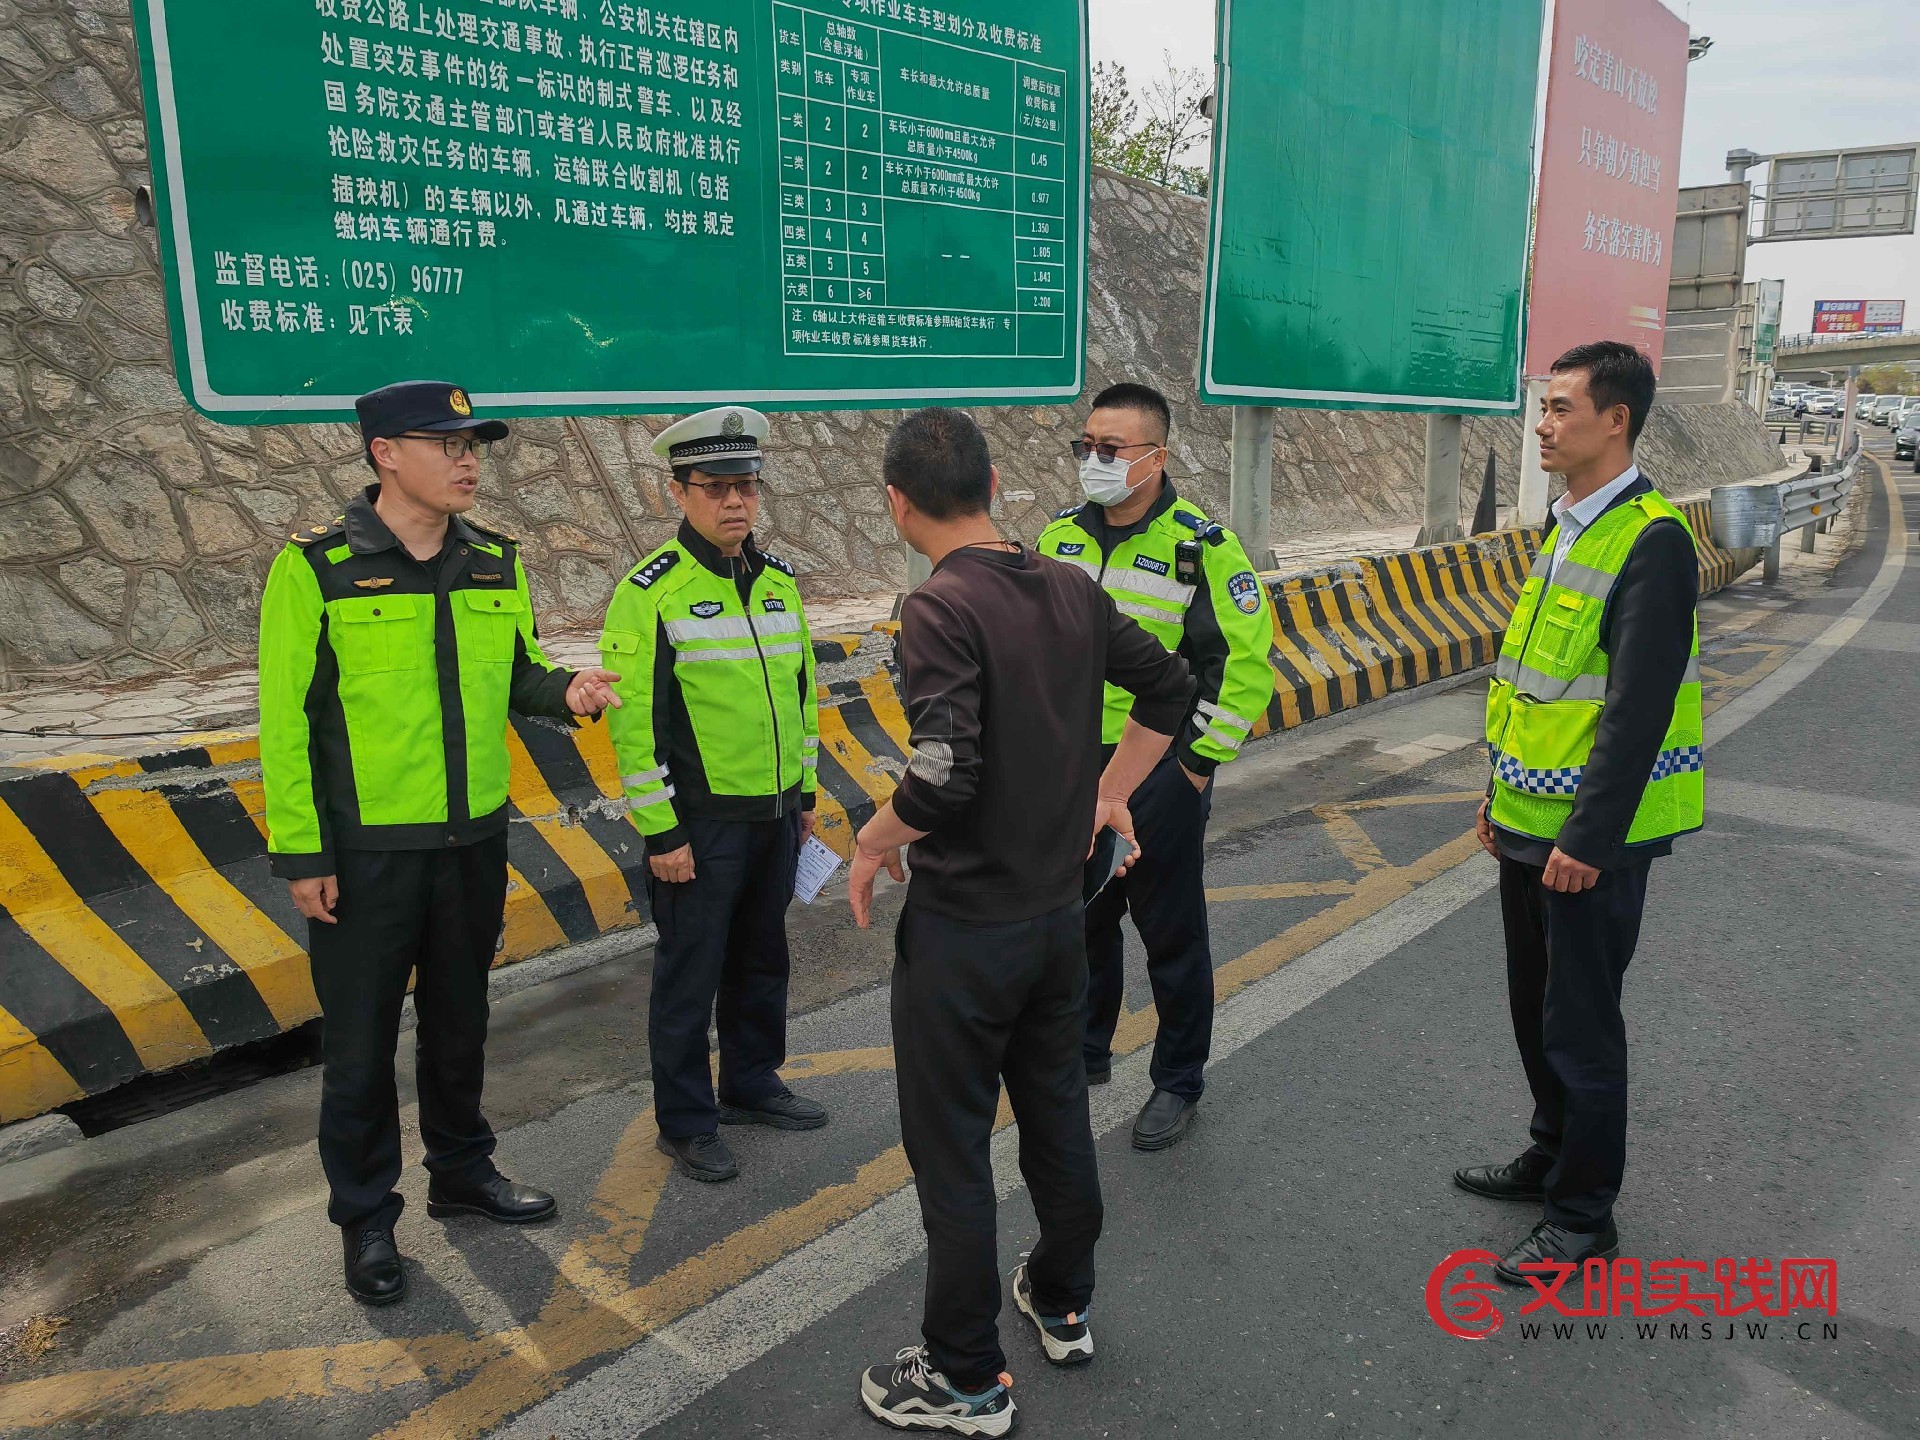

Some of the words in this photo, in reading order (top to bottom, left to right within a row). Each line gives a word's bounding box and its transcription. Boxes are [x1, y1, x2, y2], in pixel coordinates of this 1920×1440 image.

[779, 28, 801, 47] 货车
[826, 20, 857, 42] 总轴数
[780, 58, 802, 76] 类别
[814, 69, 835, 86] 货车
[850, 68, 871, 85] 专项
[846, 85, 876, 103] 作业车
[900, 67, 991, 100] 车长和最大允许总质量
[1025, 94, 1057, 113] 收费标准
[323, 80, 740, 165] 国务院交通主管部门或者省人民政府批准执行
[781, 112, 804, 128] 一类
[825, 116, 832, 132] 2
[862, 124, 869, 138] 2
[783, 155, 805, 171] 二类
[825, 161, 832, 176] 2
[861, 165, 868, 180] 2
[1031, 152, 1048, 167] 0.45
[1578, 125, 1661, 194] 只争朝夕勇担当
[783, 193, 805, 209] 三类
[825, 197, 832, 212] 3
[861, 202, 868, 217] 3
[1031, 192, 1050, 204] 0.977
[333, 210, 507, 248] 缴纳车辆通行费。
[784, 225, 806, 241] 四类
[825, 227, 832, 242] 4
[861, 231, 868, 246] 4
[1582, 209, 1662, 267] 务实落实善作为
[785, 253, 807, 269] 五类
[827, 256, 834, 271] 5
[863, 261, 870, 276] 5
[786, 282, 809, 297] 六类
[827, 284, 834, 299] 6
[220, 298, 414, 336] 收费标准：见下表
